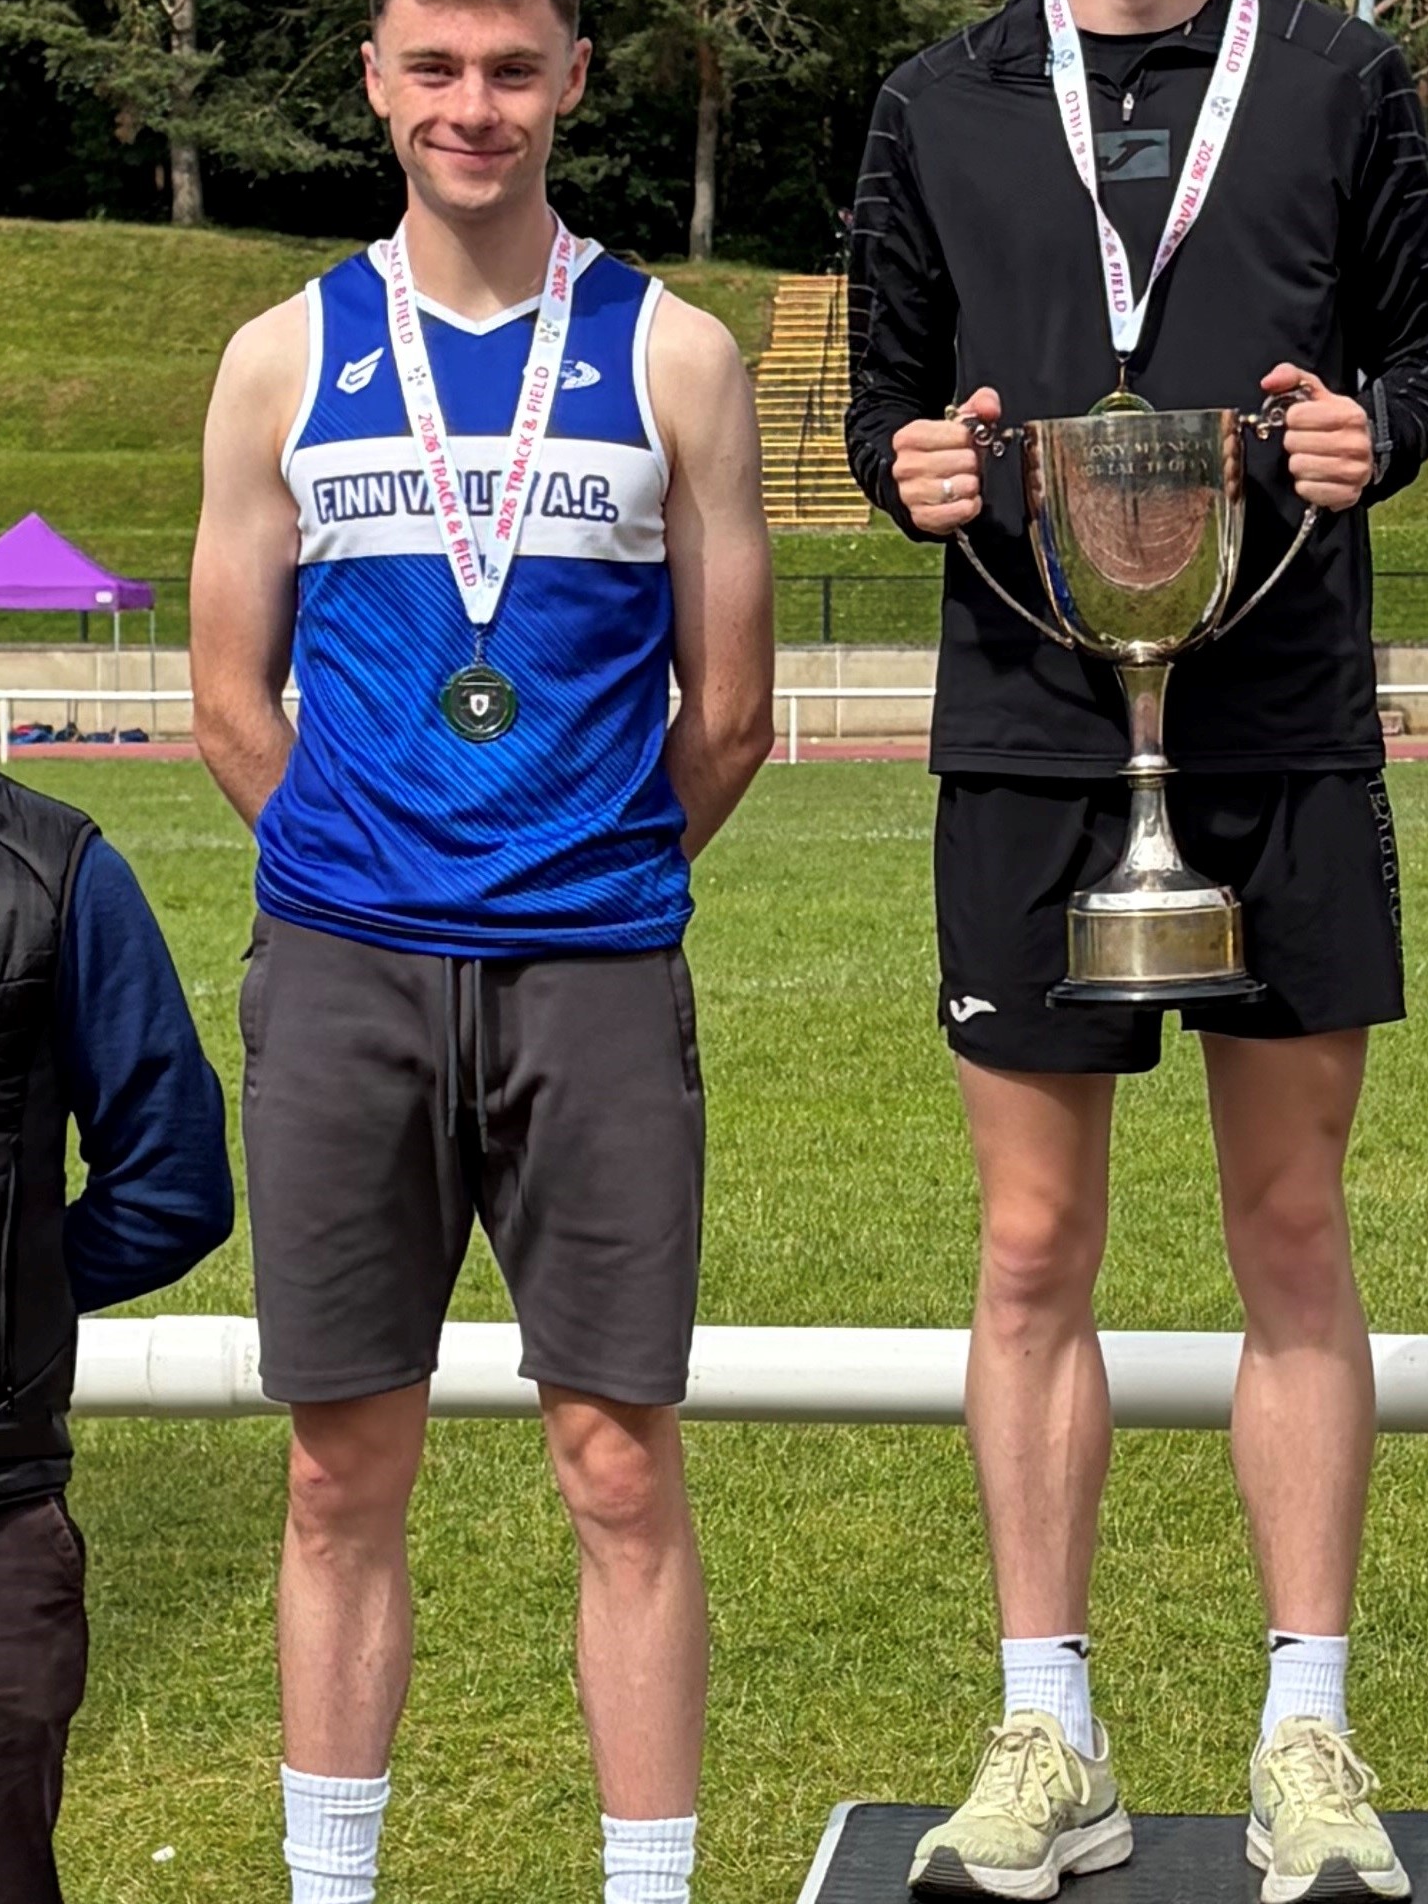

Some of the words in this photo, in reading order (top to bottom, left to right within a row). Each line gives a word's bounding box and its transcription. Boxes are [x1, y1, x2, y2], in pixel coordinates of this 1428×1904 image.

[527, 365, 550, 414] FIELD
[417, 412, 442, 453] 2026
[522, 418, 538, 431] &
[430, 455, 458, 518] TRACK
[504, 434, 535, 493] TRACK
[313, 471, 396, 524] FINN
[541, 471, 620, 524] A.C.
[495, 497, 518, 541] 2026
[446, 519, 463, 536] &
[452, 537, 478, 588] FIELD
